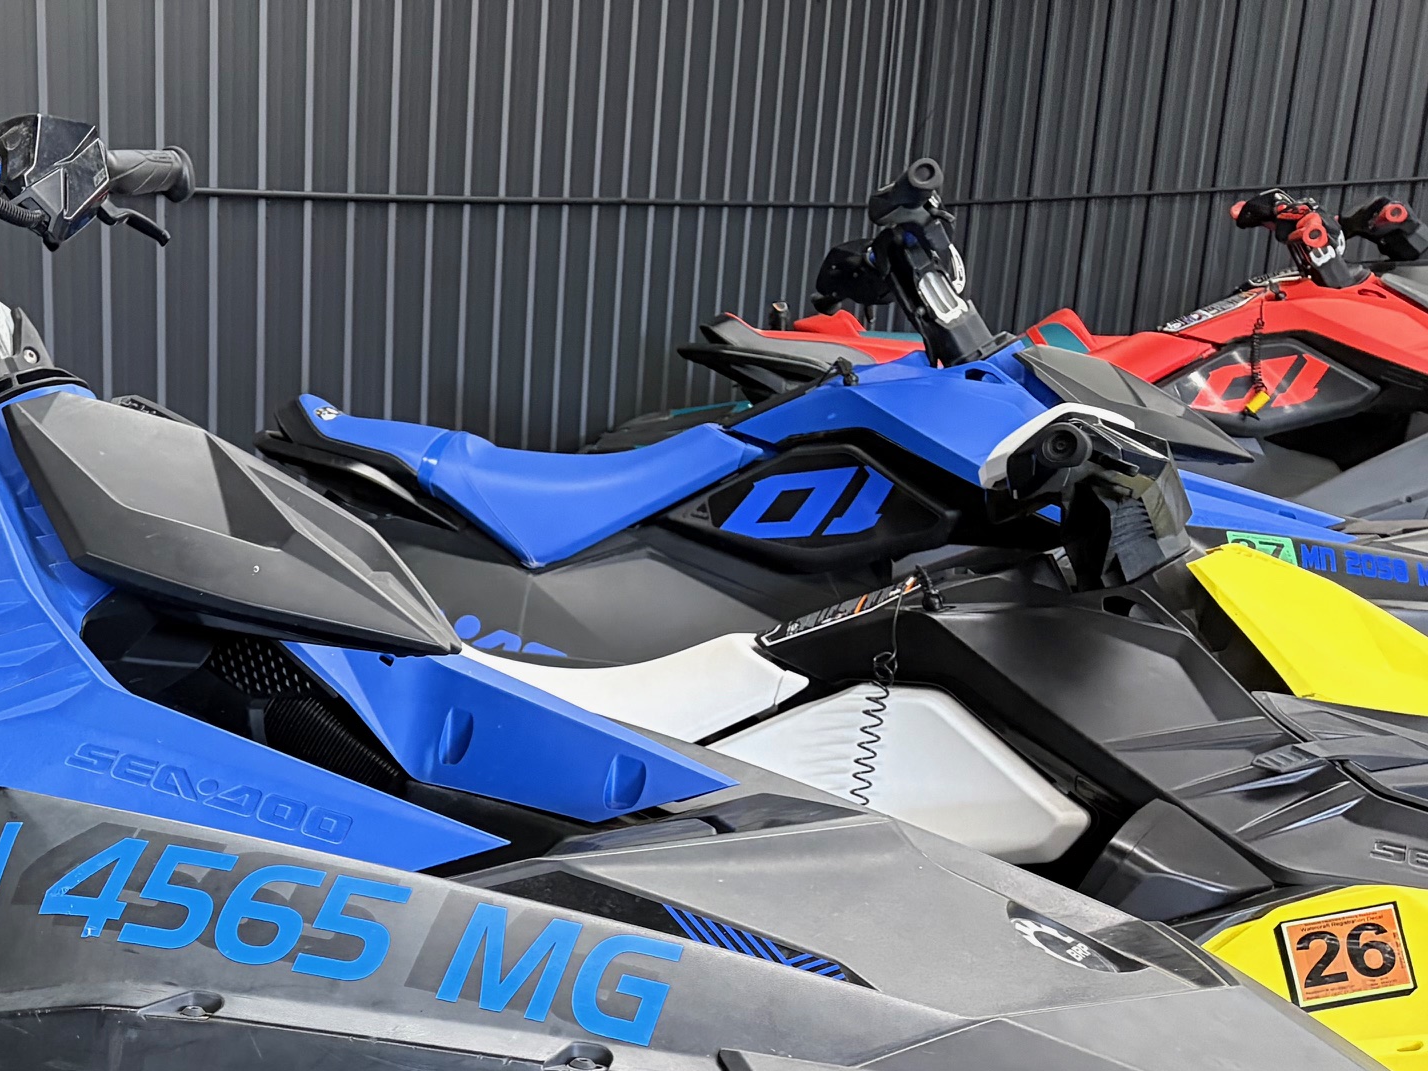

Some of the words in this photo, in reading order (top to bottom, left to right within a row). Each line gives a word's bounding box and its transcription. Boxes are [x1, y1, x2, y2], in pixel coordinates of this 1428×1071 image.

[38, 837, 413, 982] 4565
[435, 902, 684, 1047] MG
[1066, 942, 1091, 962] BRP
[1296, 922, 1396, 989] 26
